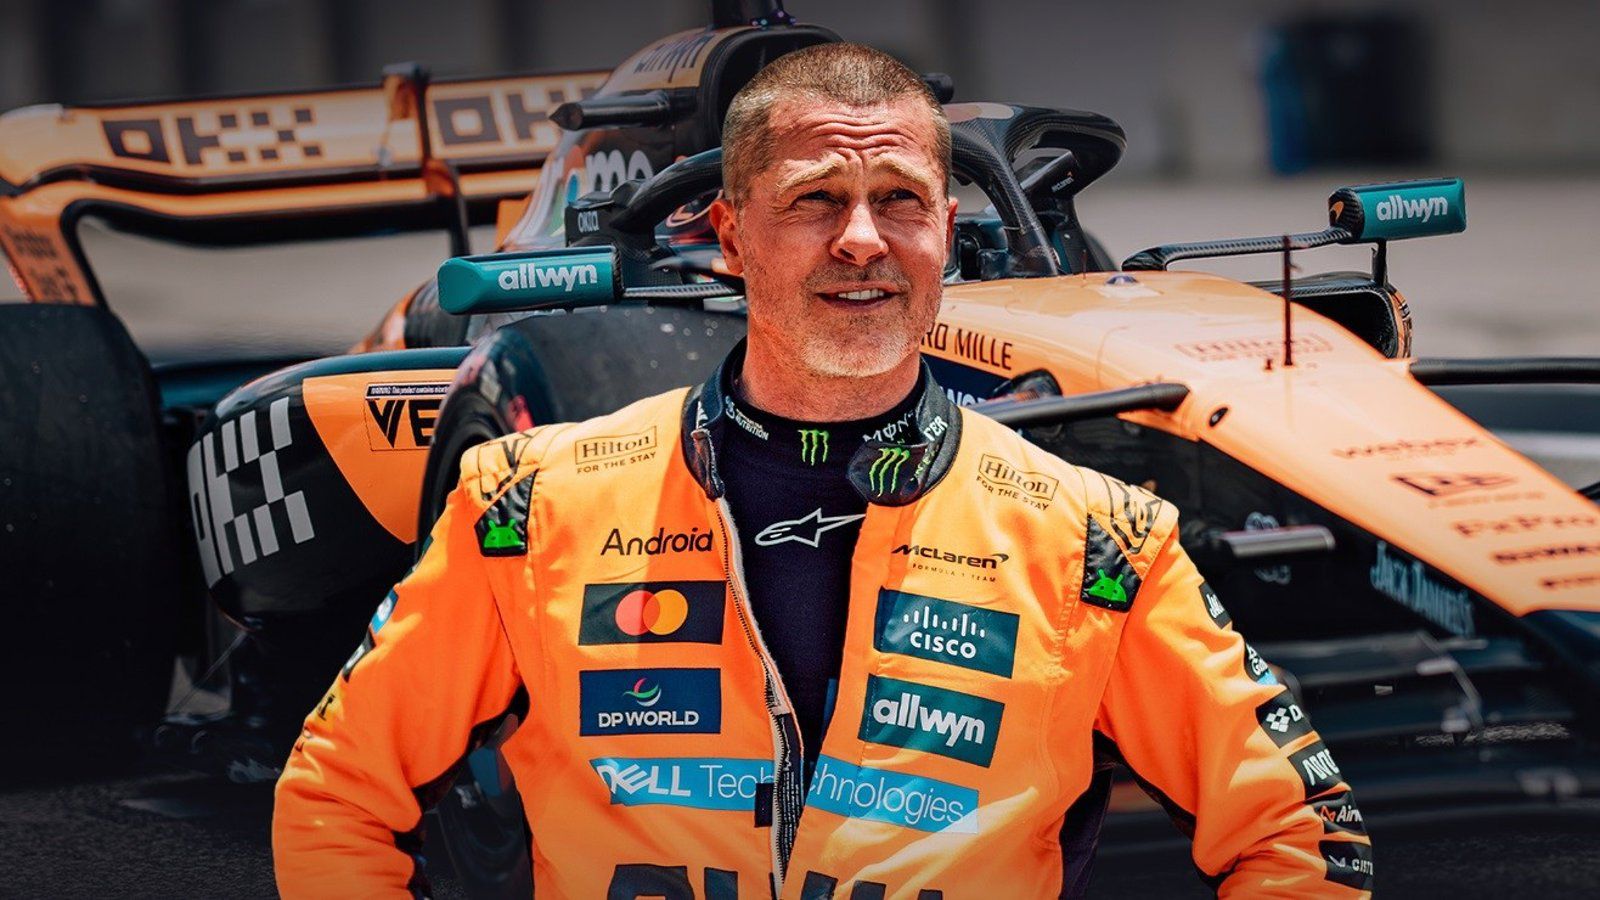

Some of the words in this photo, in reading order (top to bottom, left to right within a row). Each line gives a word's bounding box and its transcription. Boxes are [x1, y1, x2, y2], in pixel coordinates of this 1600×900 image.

[1375, 194, 1448, 223] allwyn
[498, 262, 598, 292] allwyn
[954, 328, 1013, 371] MILLE
[582, 436, 650, 458] Hilton
[577, 465, 600, 474] FOR
[604, 459, 626, 469] THE
[630, 452, 657, 464] STAY
[984, 461, 1049, 494] Hilton
[976, 475, 994, 493] FOR
[998, 488, 1020, 500] THE
[1022, 496, 1049, 511] STAY
[600, 527, 714, 557] Android
[891, 544, 998, 570] McLaren
[912, 563, 956, 577] FORMULA
[971, 574, 997, 583] TEAM
[909, 631, 977, 659] CISCO
[598, 712, 622, 728] DP
[625, 710, 700, 727] WORLD
[872, 692, 986, 748] allwyn
[596, 763, 692, 798] DELL
